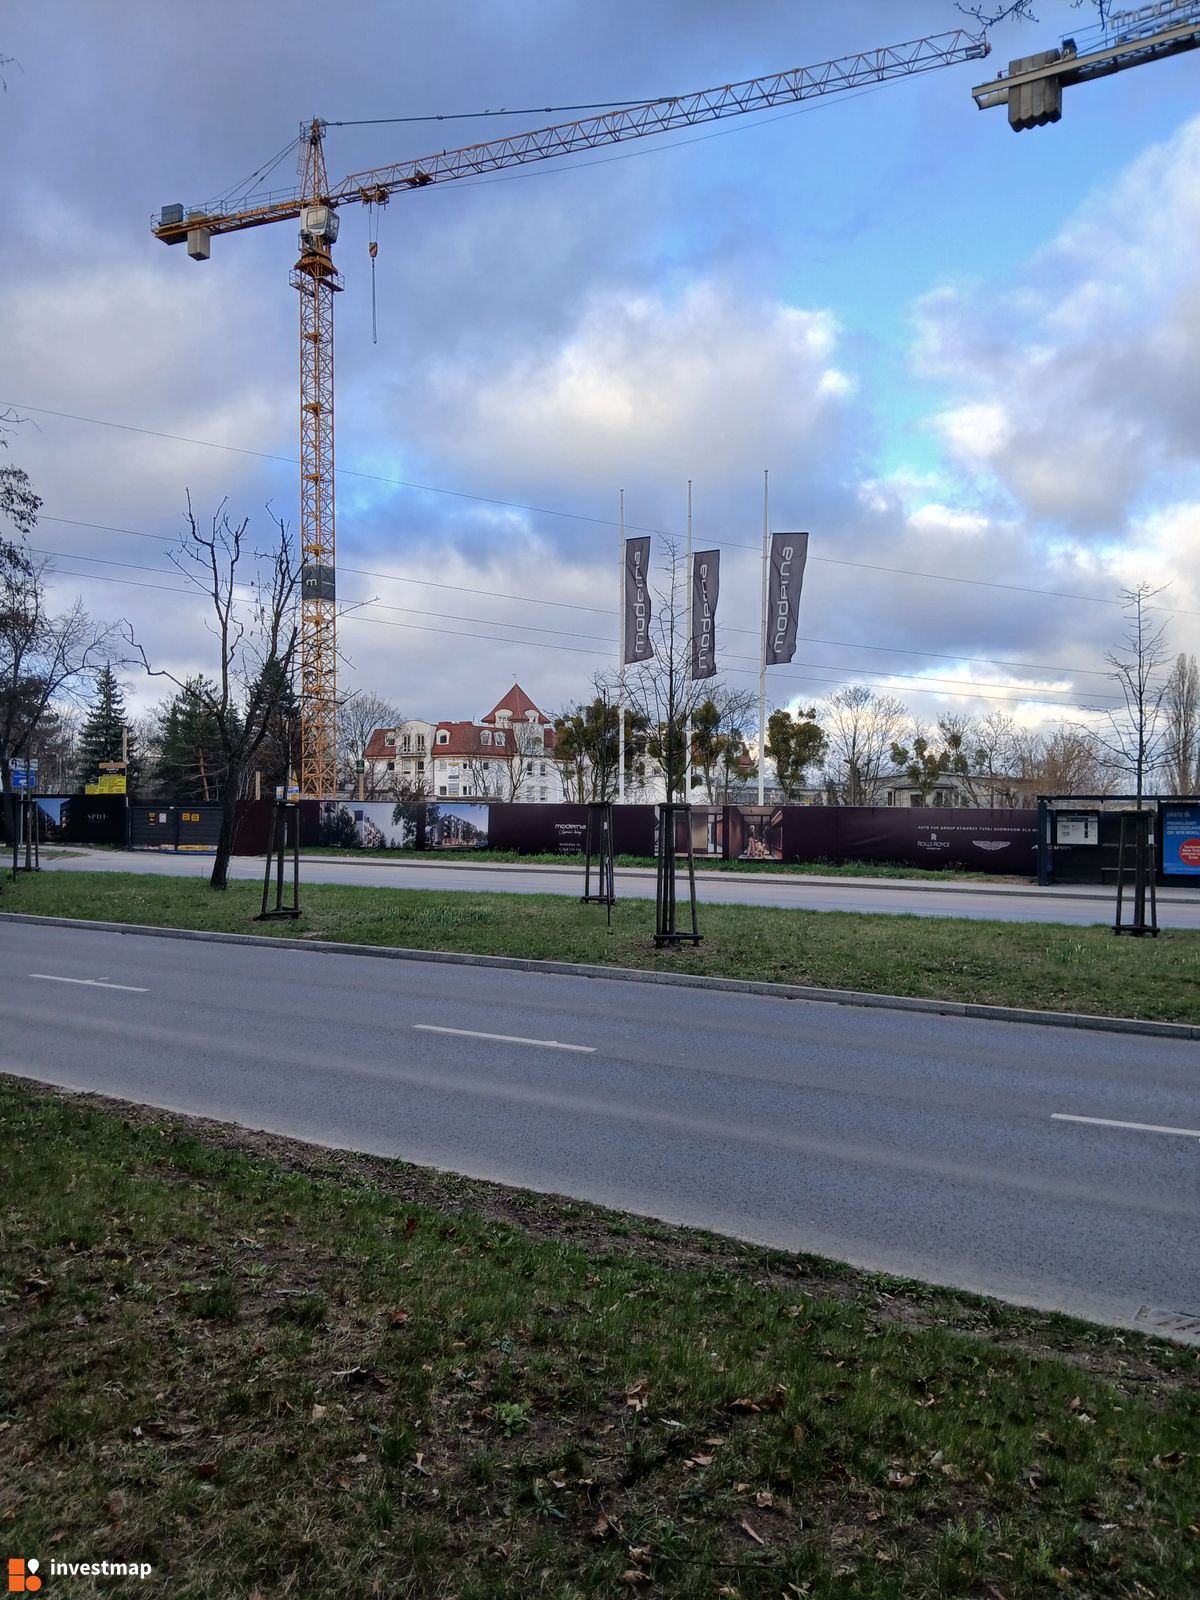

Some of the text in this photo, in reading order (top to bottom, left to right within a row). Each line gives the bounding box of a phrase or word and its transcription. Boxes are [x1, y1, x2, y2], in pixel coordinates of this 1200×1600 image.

[634, 551, 646, 653] moderna
[698, 564, 712, 669] moderna
[773, 546, 793, 653] moderna
